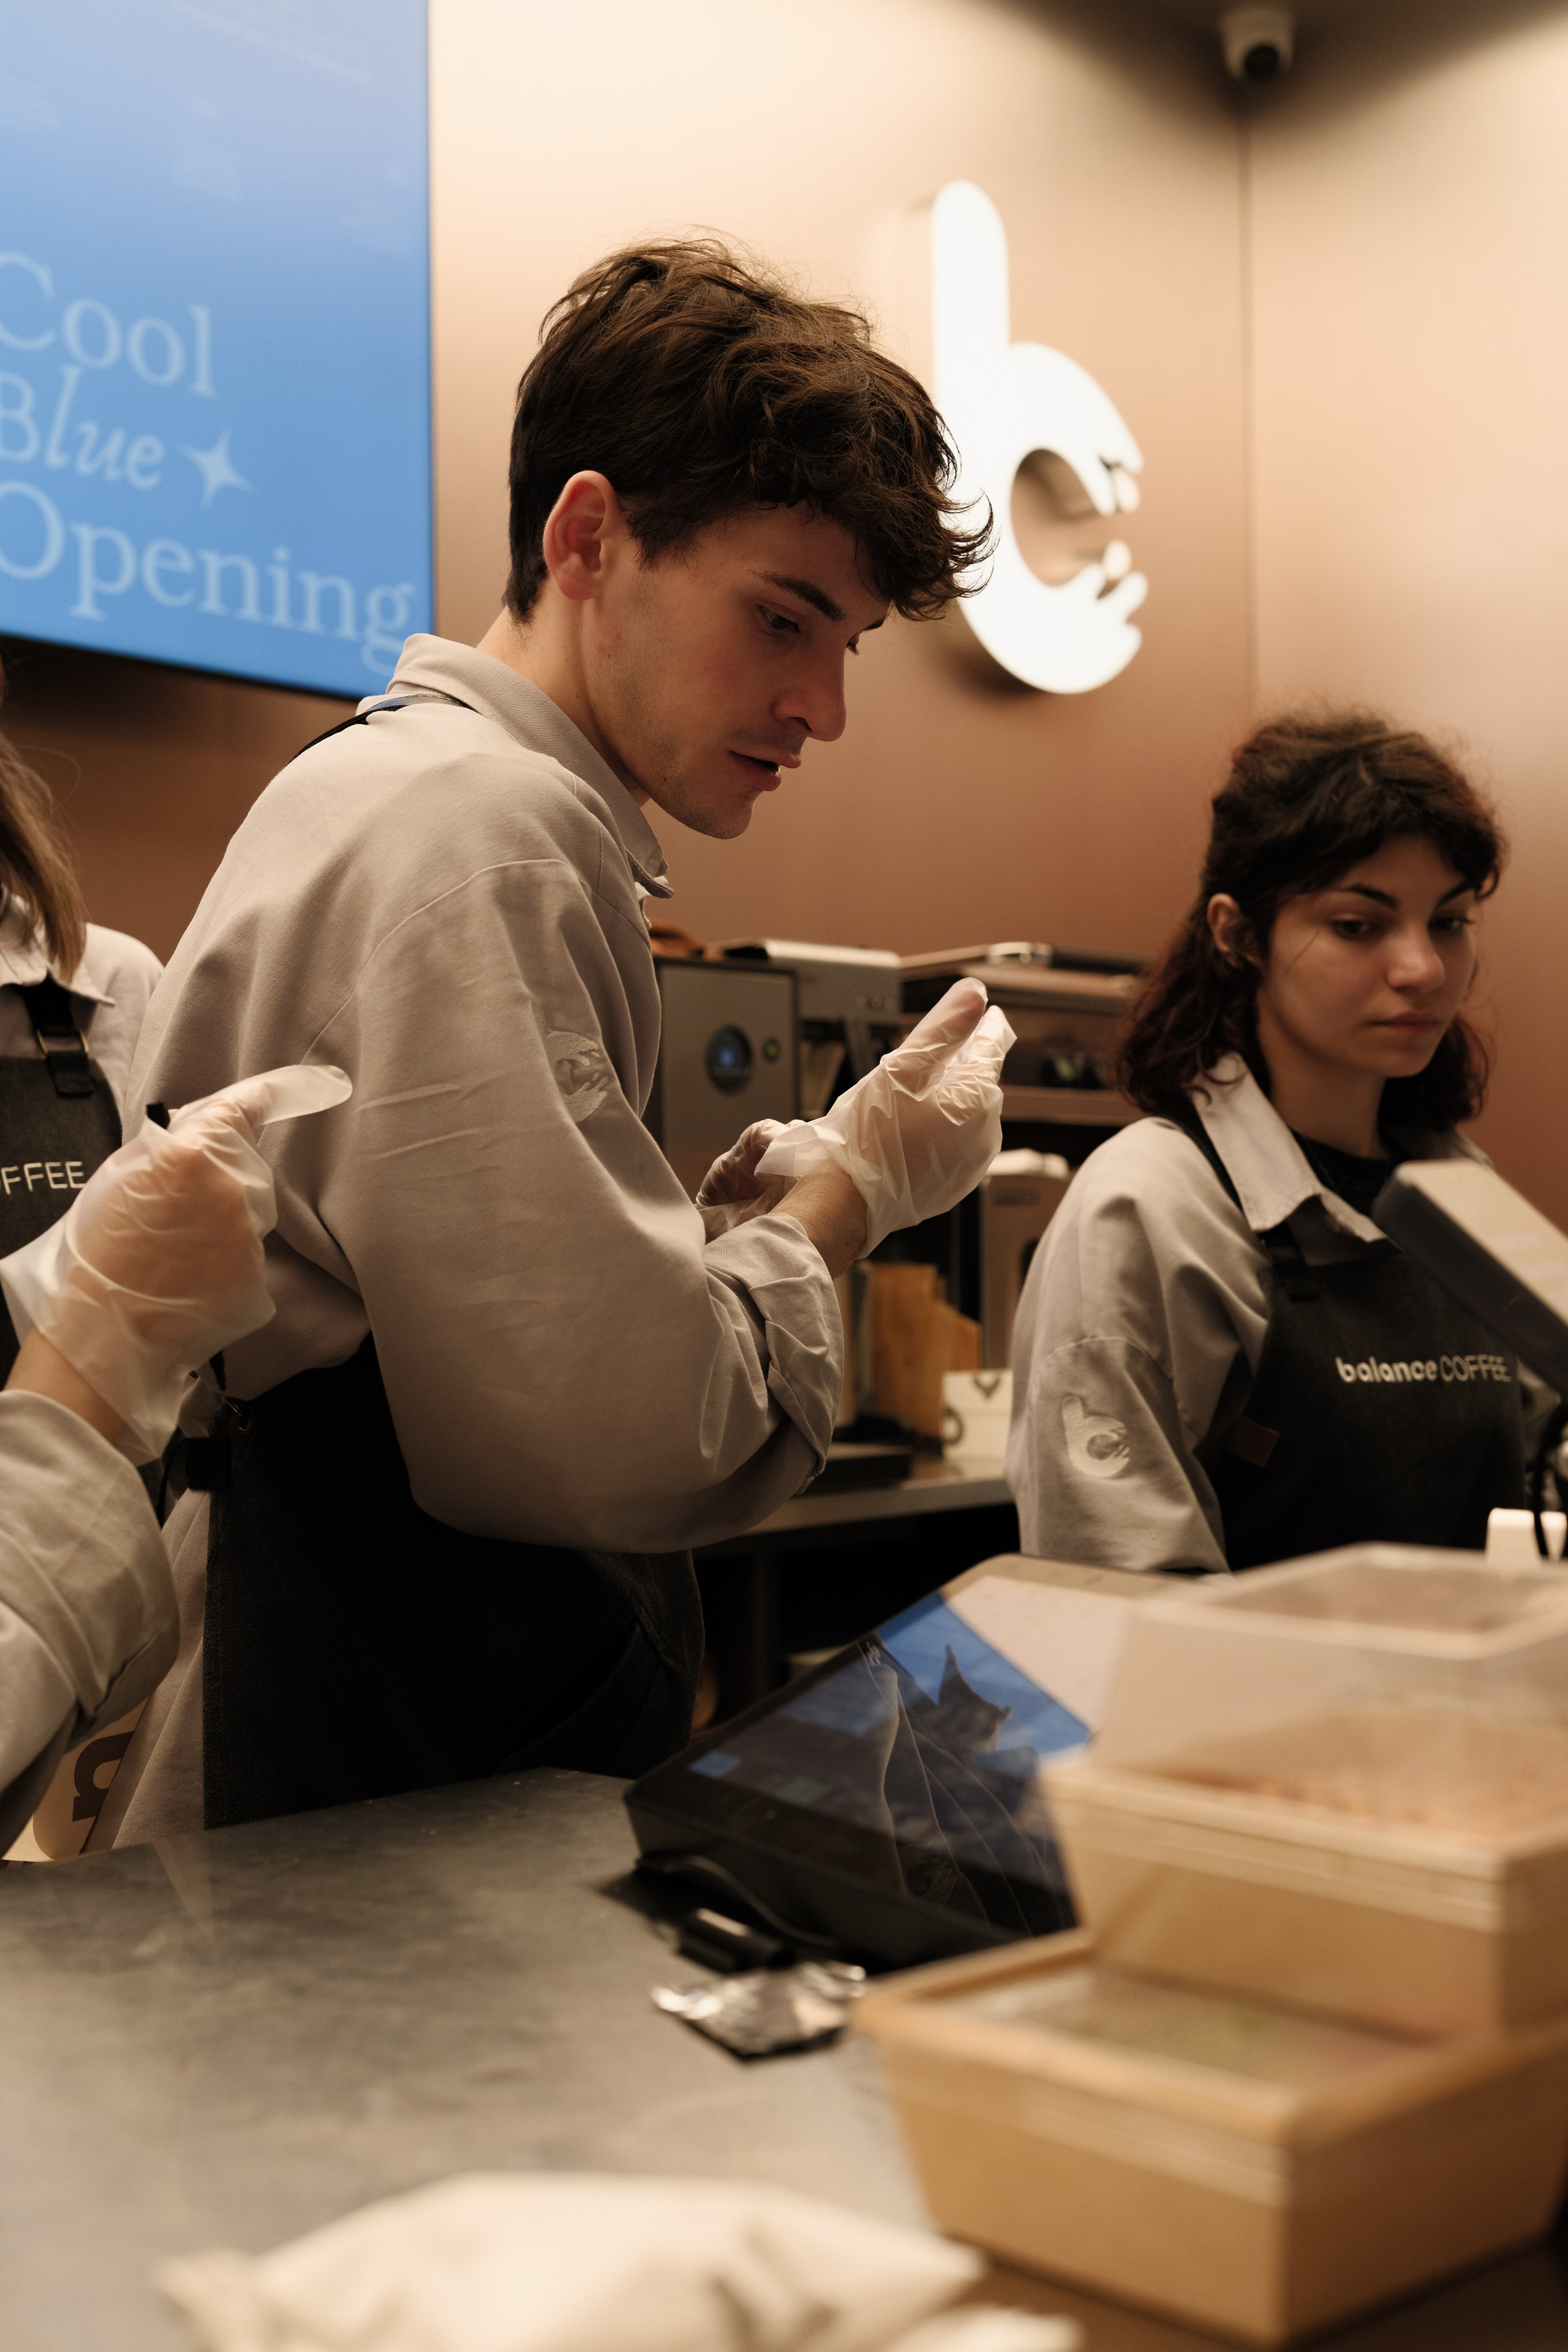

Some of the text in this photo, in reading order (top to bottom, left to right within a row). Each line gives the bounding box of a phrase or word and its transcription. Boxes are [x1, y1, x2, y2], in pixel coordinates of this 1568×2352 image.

[0, 252, 218, 398] Cool
[0, 366, 165, 490] Blue
[0, 481, 418, 676] Opening
[0, 1161, 86, 1194] FFEE
